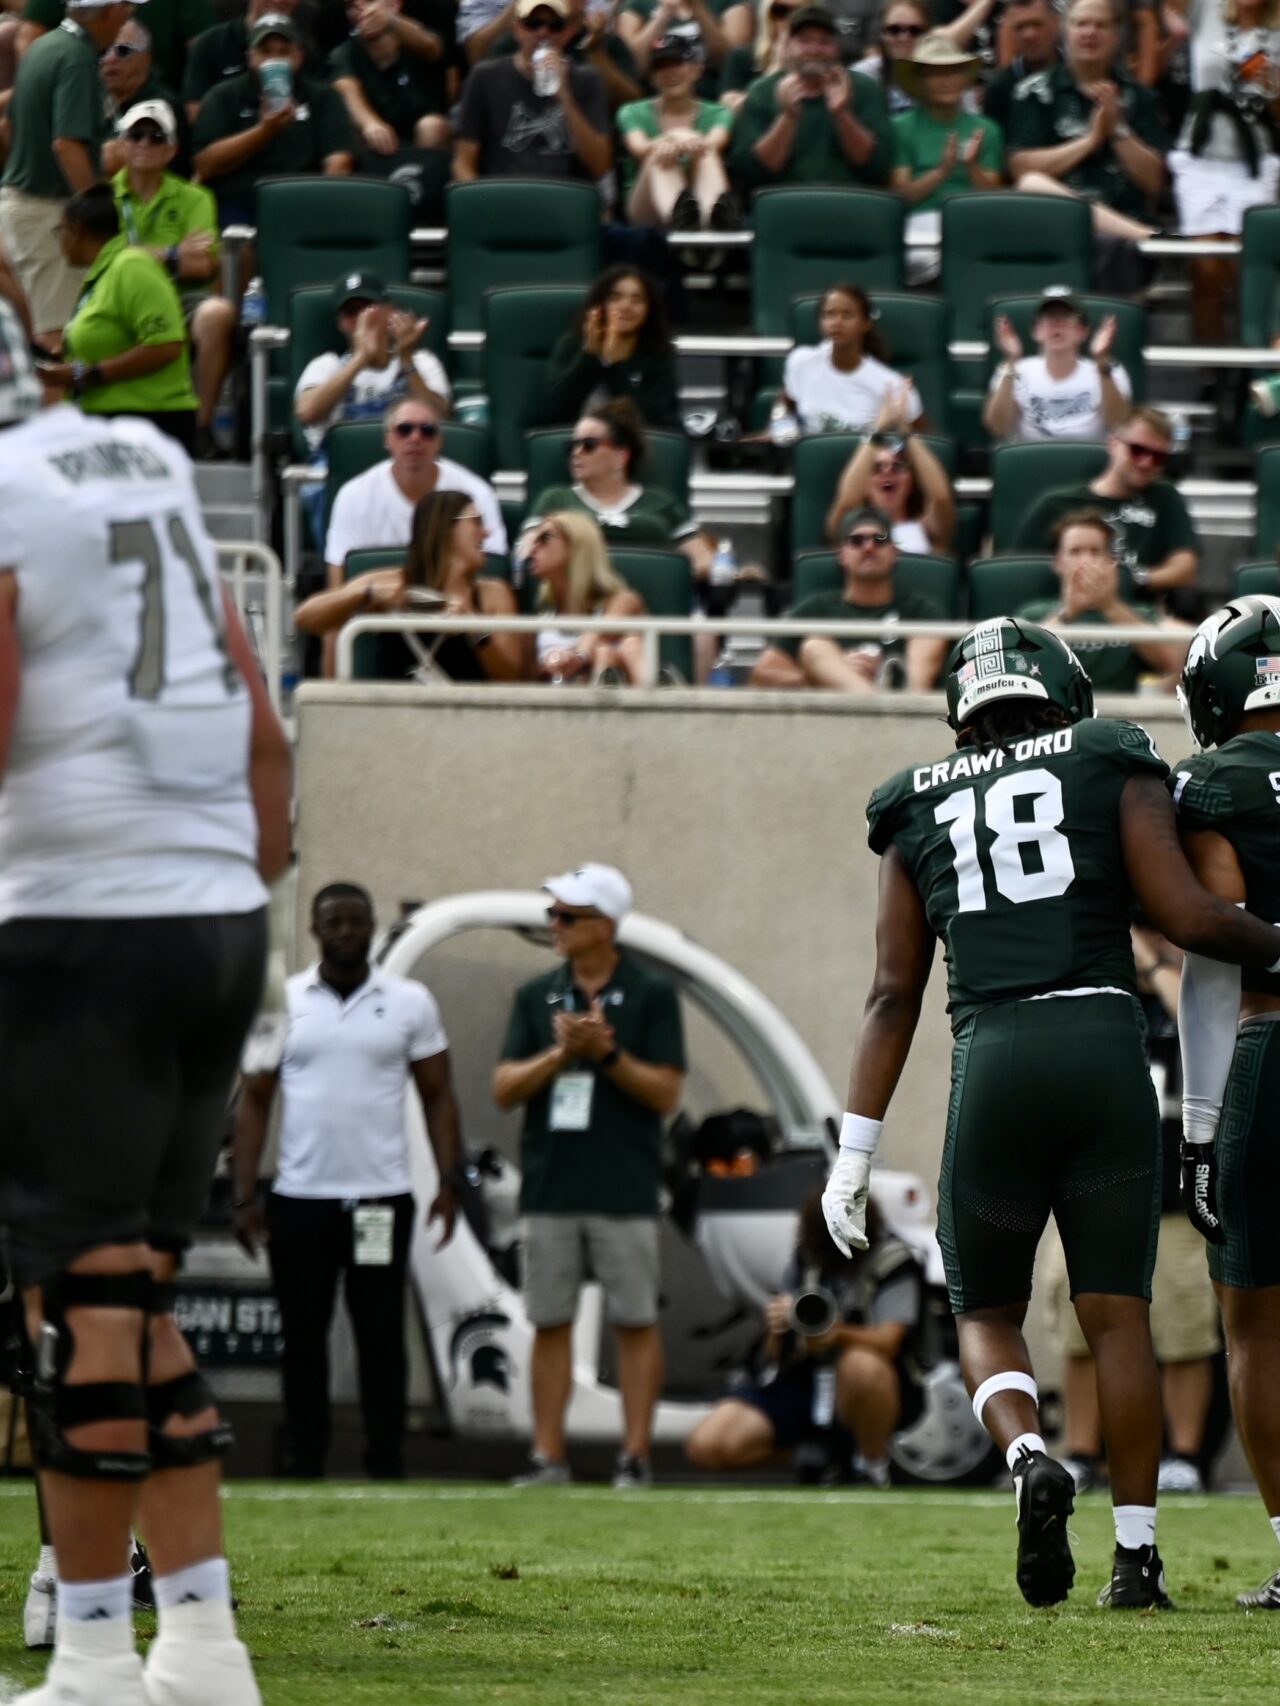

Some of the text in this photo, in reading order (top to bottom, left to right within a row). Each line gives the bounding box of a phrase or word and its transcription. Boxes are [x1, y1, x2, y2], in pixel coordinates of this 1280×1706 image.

[976, 678, 1015, 695] msufcu
[934, 768, 1076, 913] 18
[1195, 1163, 1219, 1228] SPARTANS
